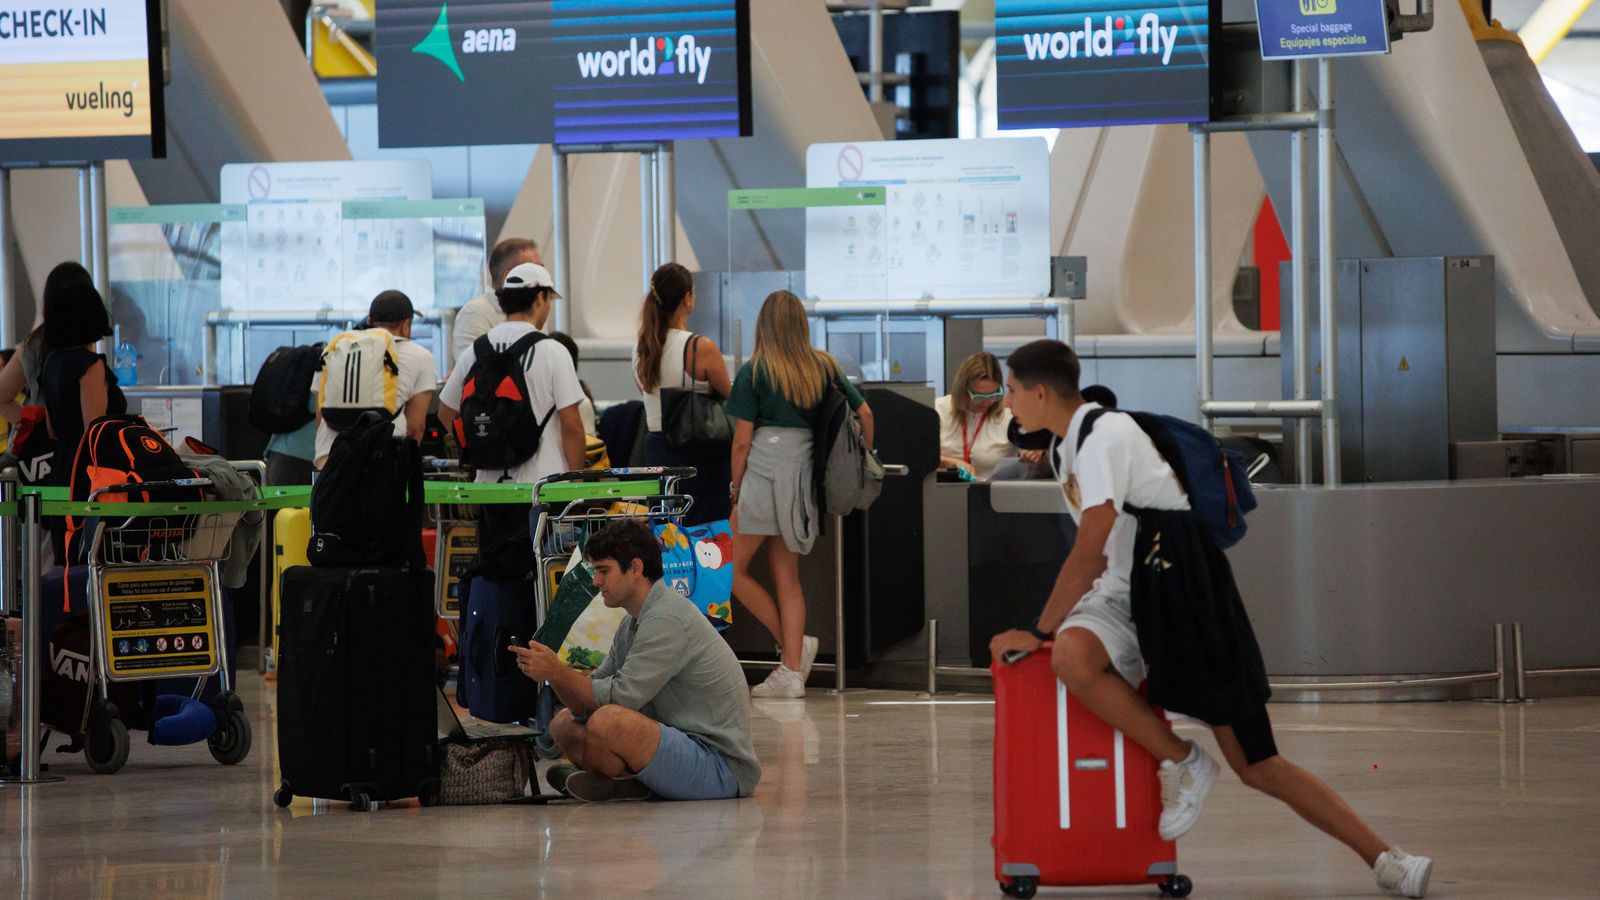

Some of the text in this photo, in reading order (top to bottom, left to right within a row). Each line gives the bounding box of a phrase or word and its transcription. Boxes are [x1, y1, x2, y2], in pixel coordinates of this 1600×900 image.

[0, 8, 107, 39] CHECK-IN
[1290, 22, 1352, 34] Special baggage
[462, 27, 516, 53] aena
[1280, 34, 1367, 49] Equipajes especiales
[66, 81, 133, 117] vueling
[1460, 259, 1470, 268] 04
[49, 642, 91, 685] VAN
